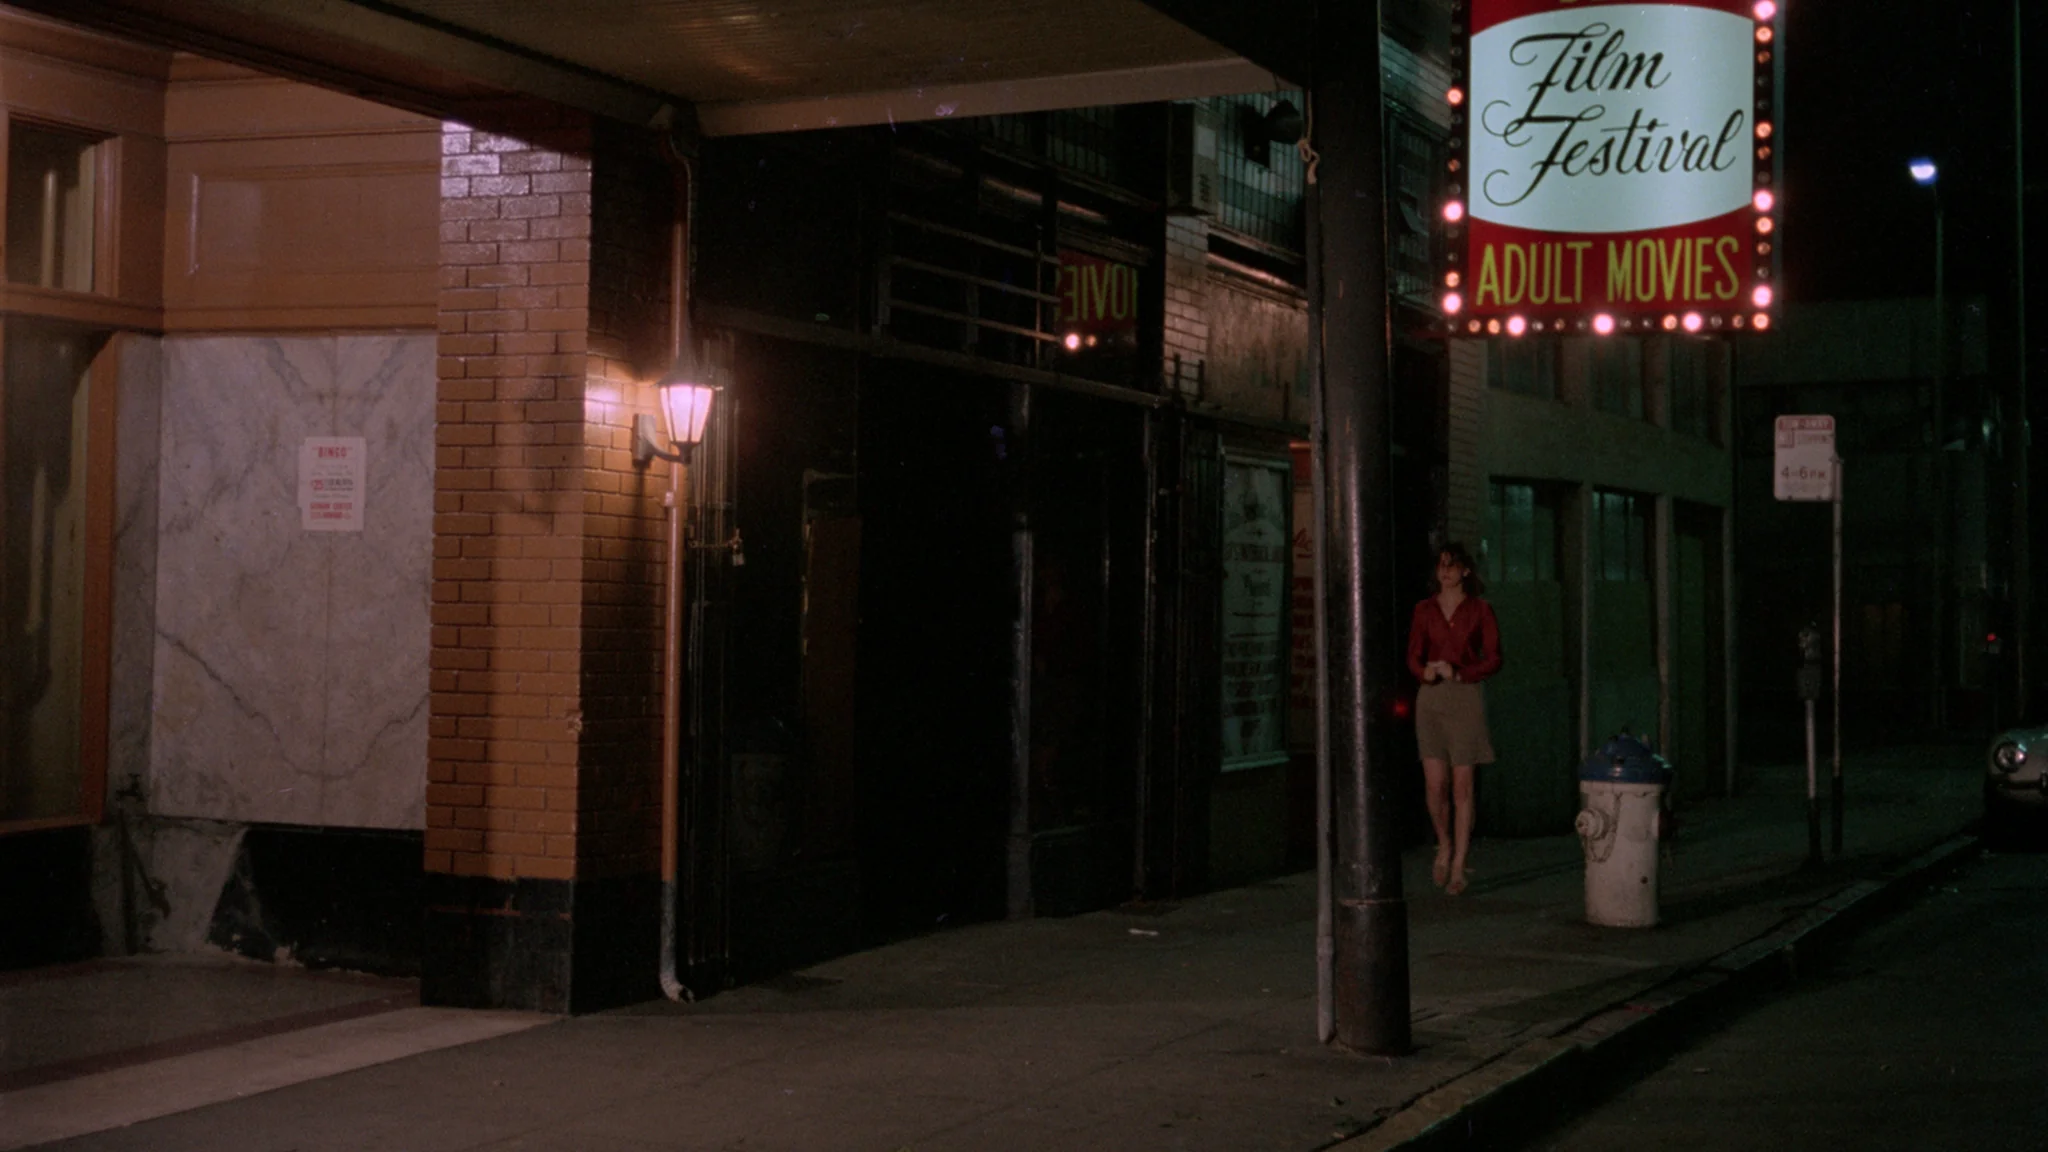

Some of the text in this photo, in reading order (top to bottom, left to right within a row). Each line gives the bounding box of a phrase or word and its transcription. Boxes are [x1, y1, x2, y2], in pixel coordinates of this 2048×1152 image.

[1482, 23, 1671, 136] Film
[1484, 105, 1744, 206] Festival
[1475, 235, 1740, 306] ADULT MOVIES
